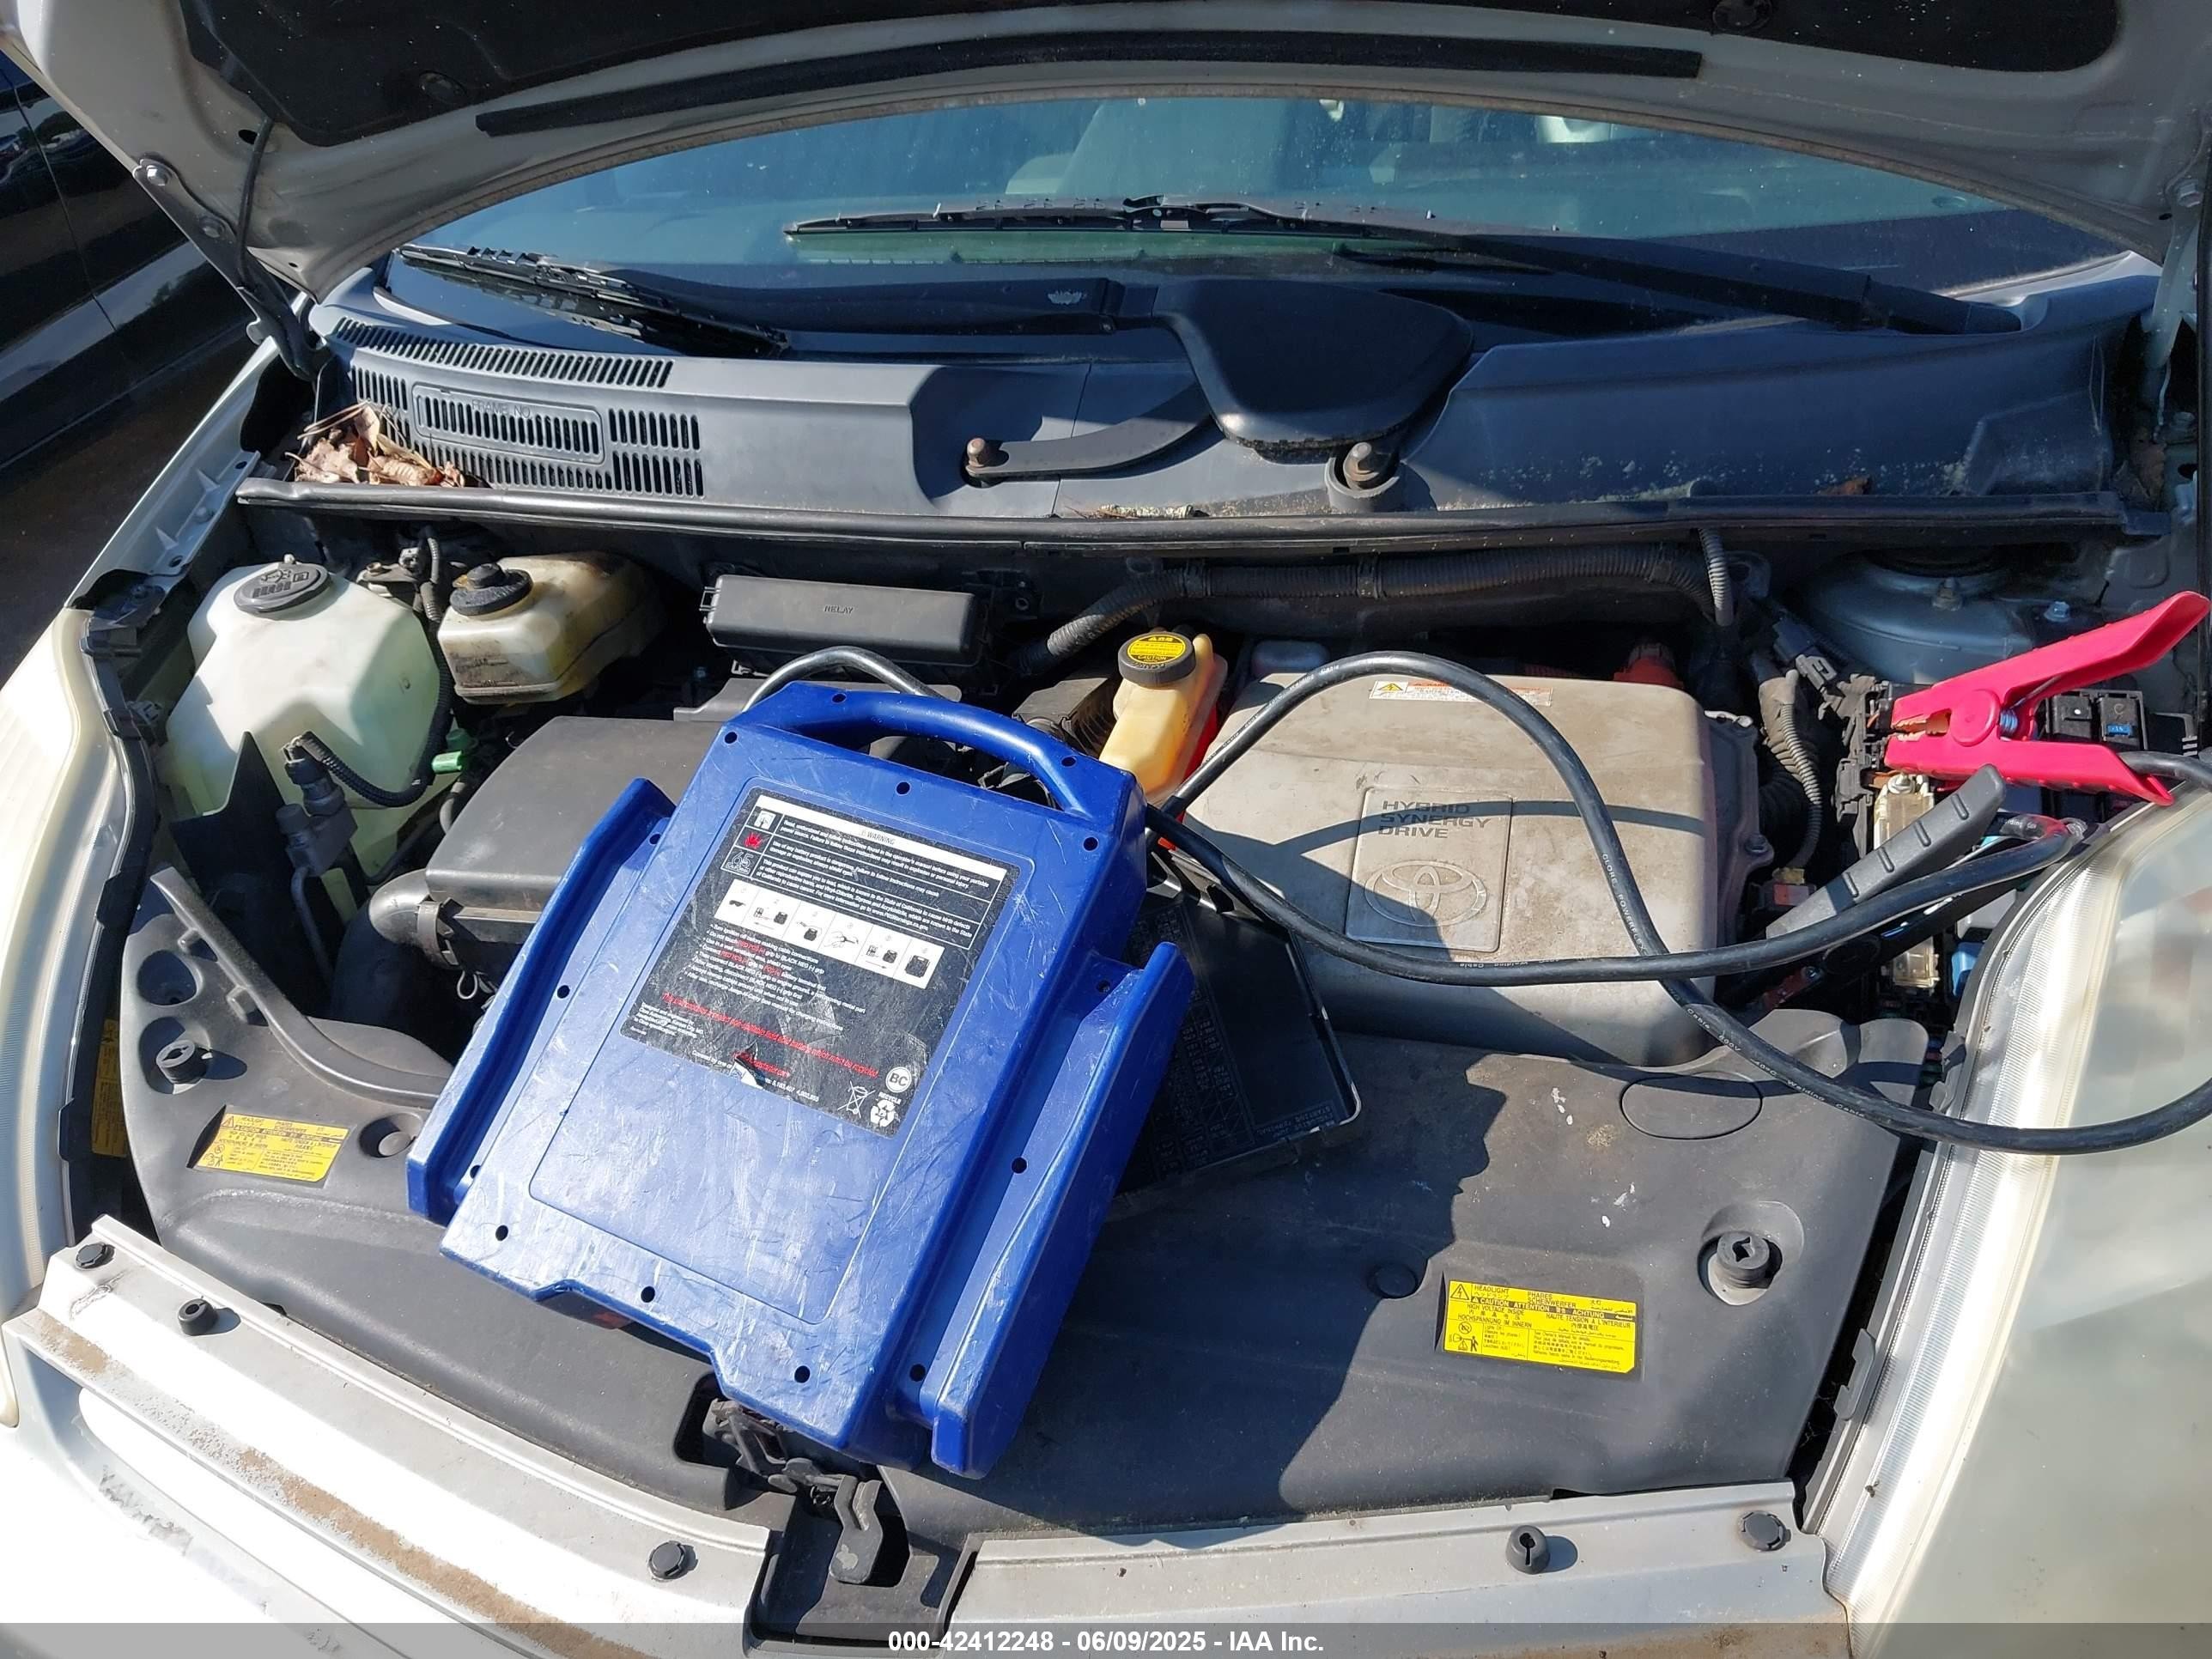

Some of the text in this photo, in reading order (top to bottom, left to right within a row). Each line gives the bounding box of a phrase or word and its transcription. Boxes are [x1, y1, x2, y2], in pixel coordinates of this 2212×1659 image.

[824, 605, 854, 614] RELAY
[1382, 800, 1470, 814] HYBRID
[1381, 813, 1491, 828] SYNERGY
[866, 831, 896, 845] WARNING
[1378, 826, 1448, 838] DRIVE
[1686, 1008, 1711, 1030] Cable
[1718, 1035, 1741, 1052] 600V
[1787, 1079, 1825, 1102] Welding
[1835, 1103, 1865, 1118] Cable
[888, 1072, 908, 1086] BC
[877, 1091, 902, 1104] RECYCLE
[1474, 1285, 1509, 1294] HEADLIGHT
[1528, 1291, 1553, 1299] PHARES
[1480, 1297, 1510, 1306] CAUTION
[1514, 1302, 1550, 1312] ATTENTION
[1572, 1310, 1605, 1319] ACHTUNG
[1482, 1304, 1505, 1314] VOLTAGE
[1528, 1297, 1577, 1308] SCHEINWERFER
[1458, 1313, 1501, 1325] HOCHSPANNUNG
[1512, 1320, 1532, 1328] INNERN
[1566, 1315, 1589, 1324] TENSION
